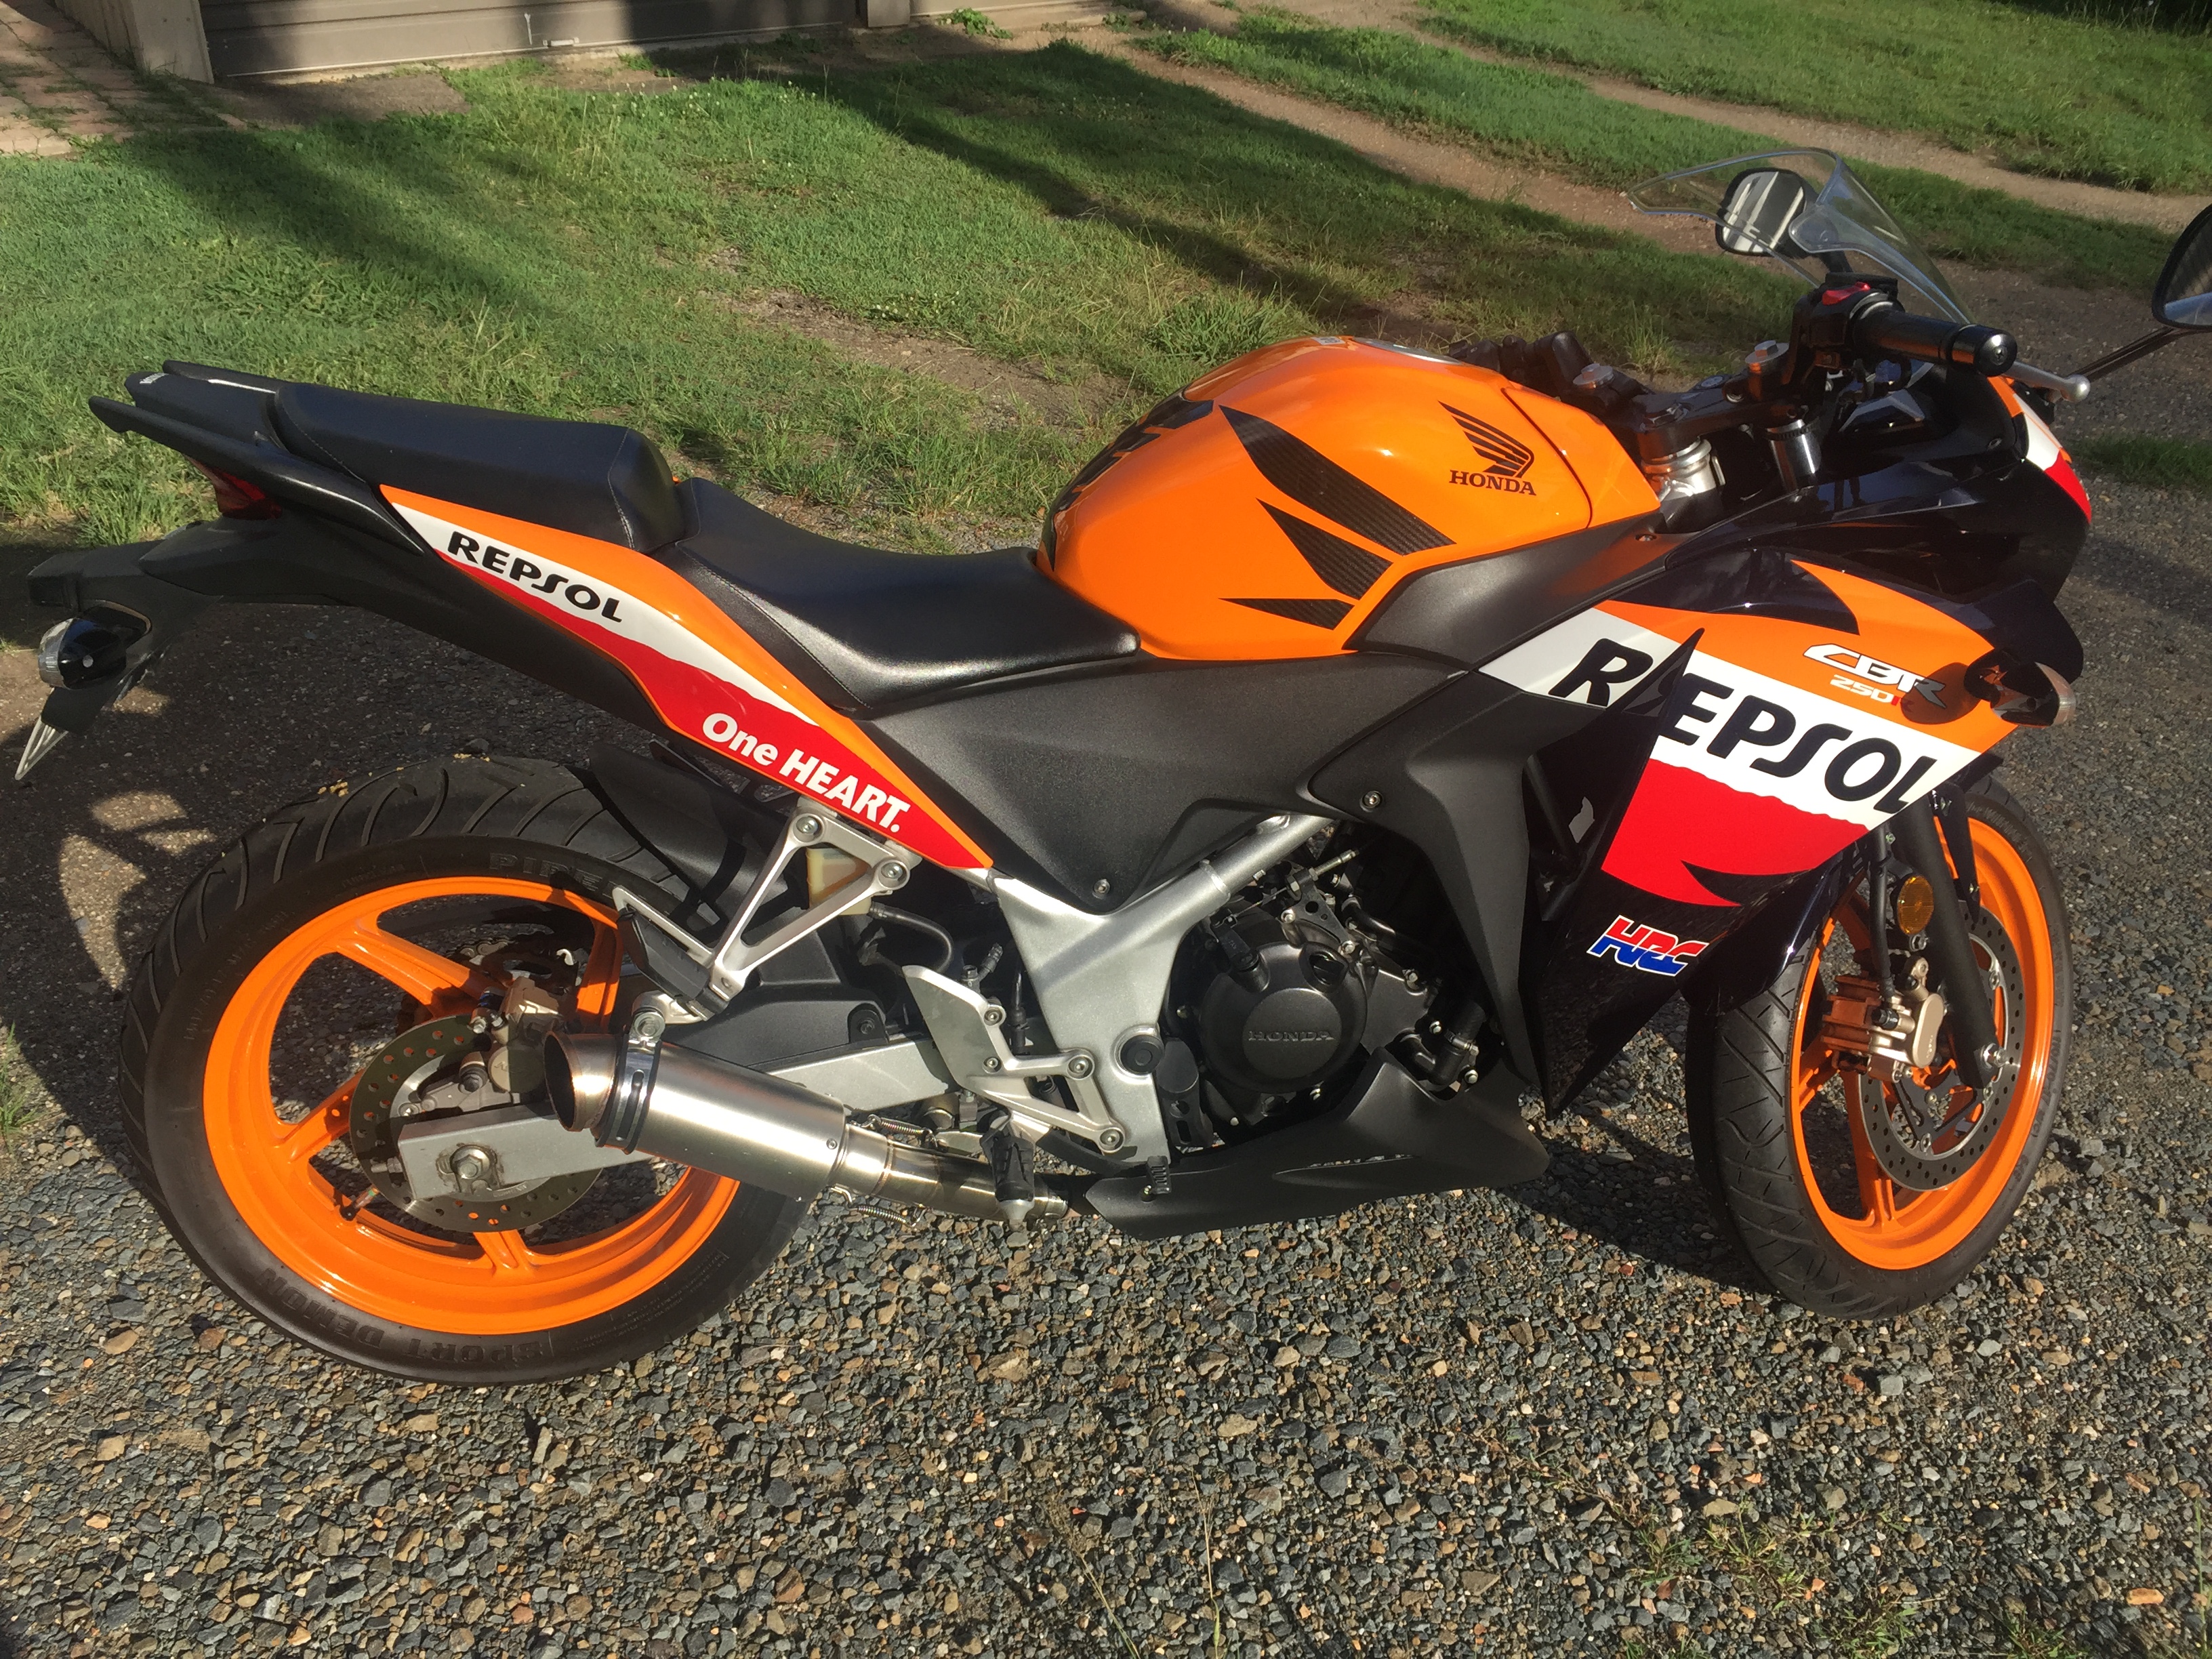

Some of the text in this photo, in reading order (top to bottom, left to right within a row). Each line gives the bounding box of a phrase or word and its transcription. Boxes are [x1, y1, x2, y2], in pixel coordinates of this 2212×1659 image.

[1449, 470, 1536, 495] HONDA
[447, 531, 622, 623] REPSOL
[1803, 643, 1947, 710] CBR
[703, 713, 911, 833] One HEART.
[1586, 915, 1709, 977] HRC
[1248, 1030, 1334, 1042] HONDA
[254, 1269, 545, 1364] SPORT DEMON
